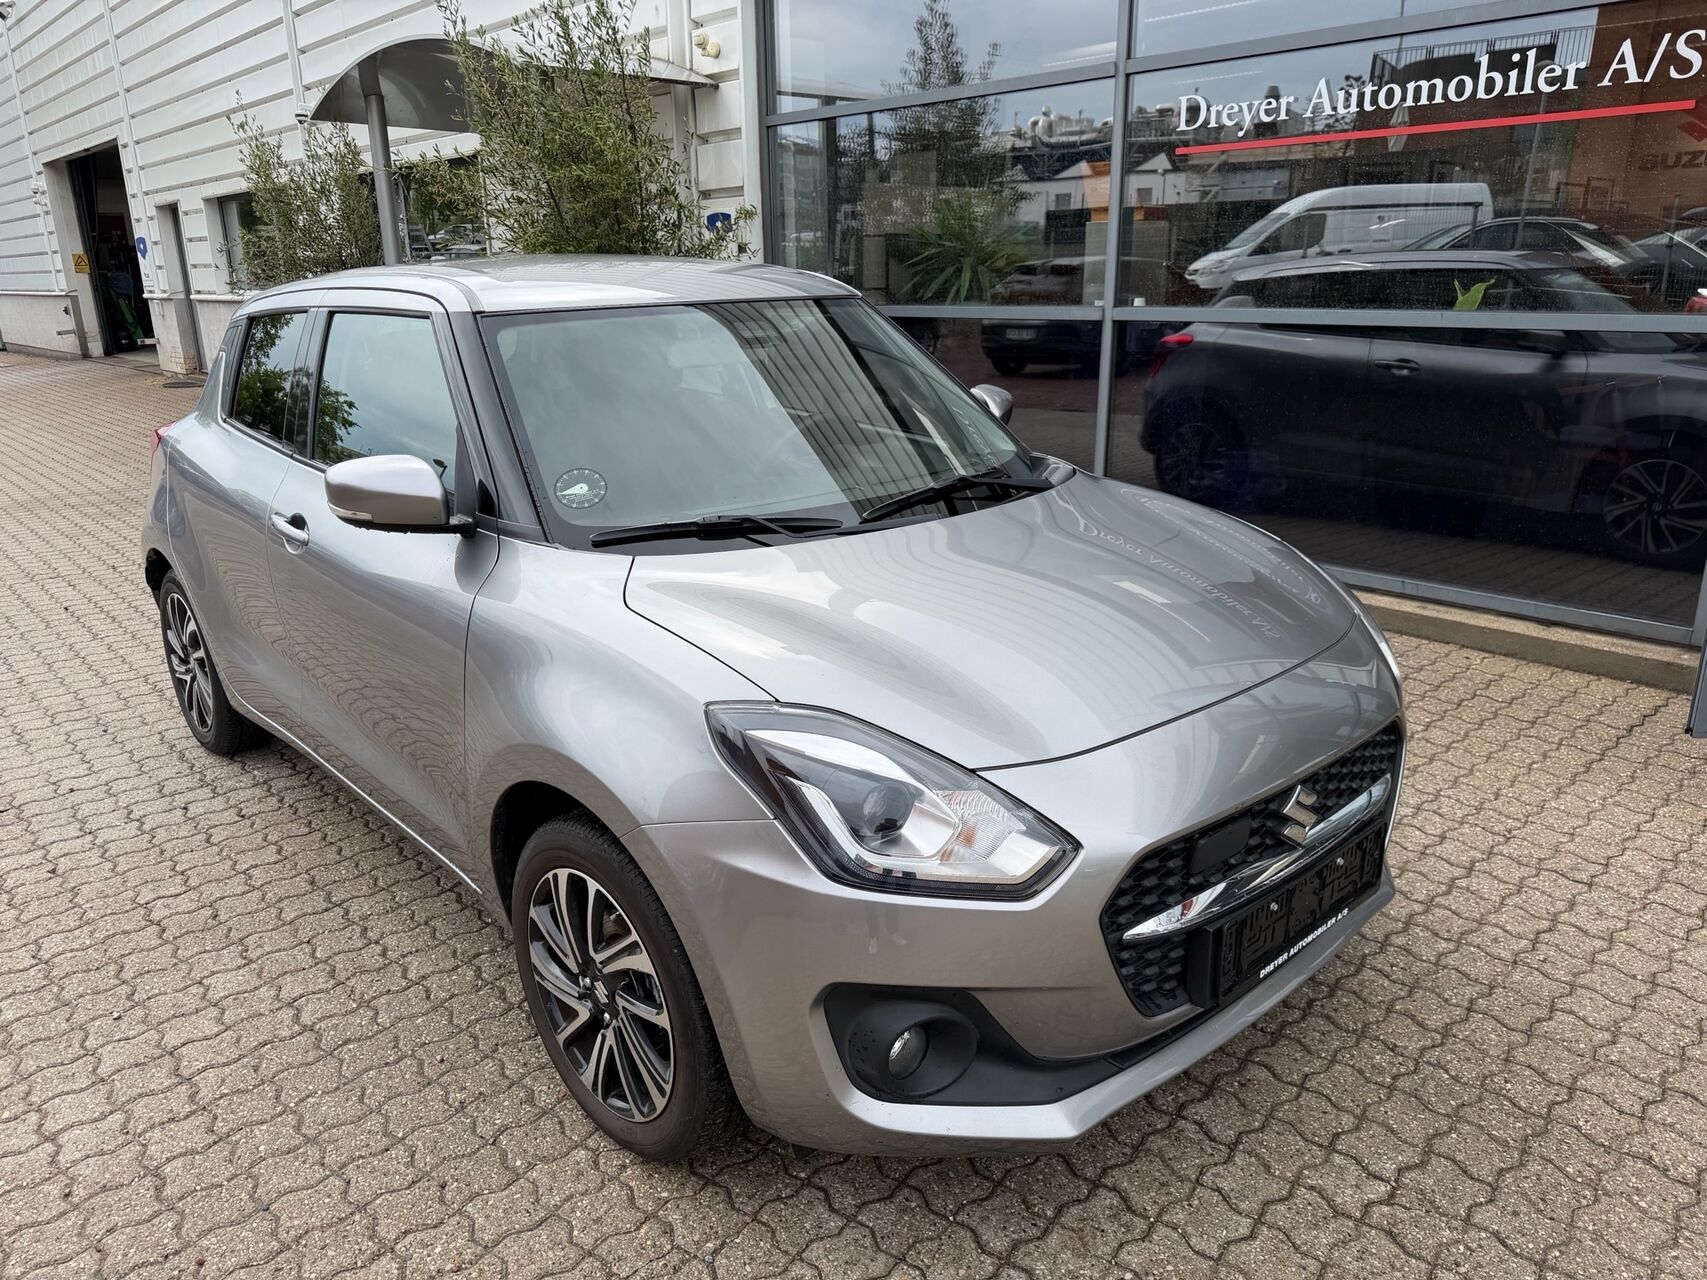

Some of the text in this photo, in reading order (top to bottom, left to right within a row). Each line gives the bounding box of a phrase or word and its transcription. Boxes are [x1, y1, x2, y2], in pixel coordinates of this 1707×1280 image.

[1176, 29, 1706, 137] Dreyer Automobiler A/S
[1638, 150, 1707, 171] SUZ
[1260, 908, 1349, 978] DREYER AUTOMOBILER A/S
